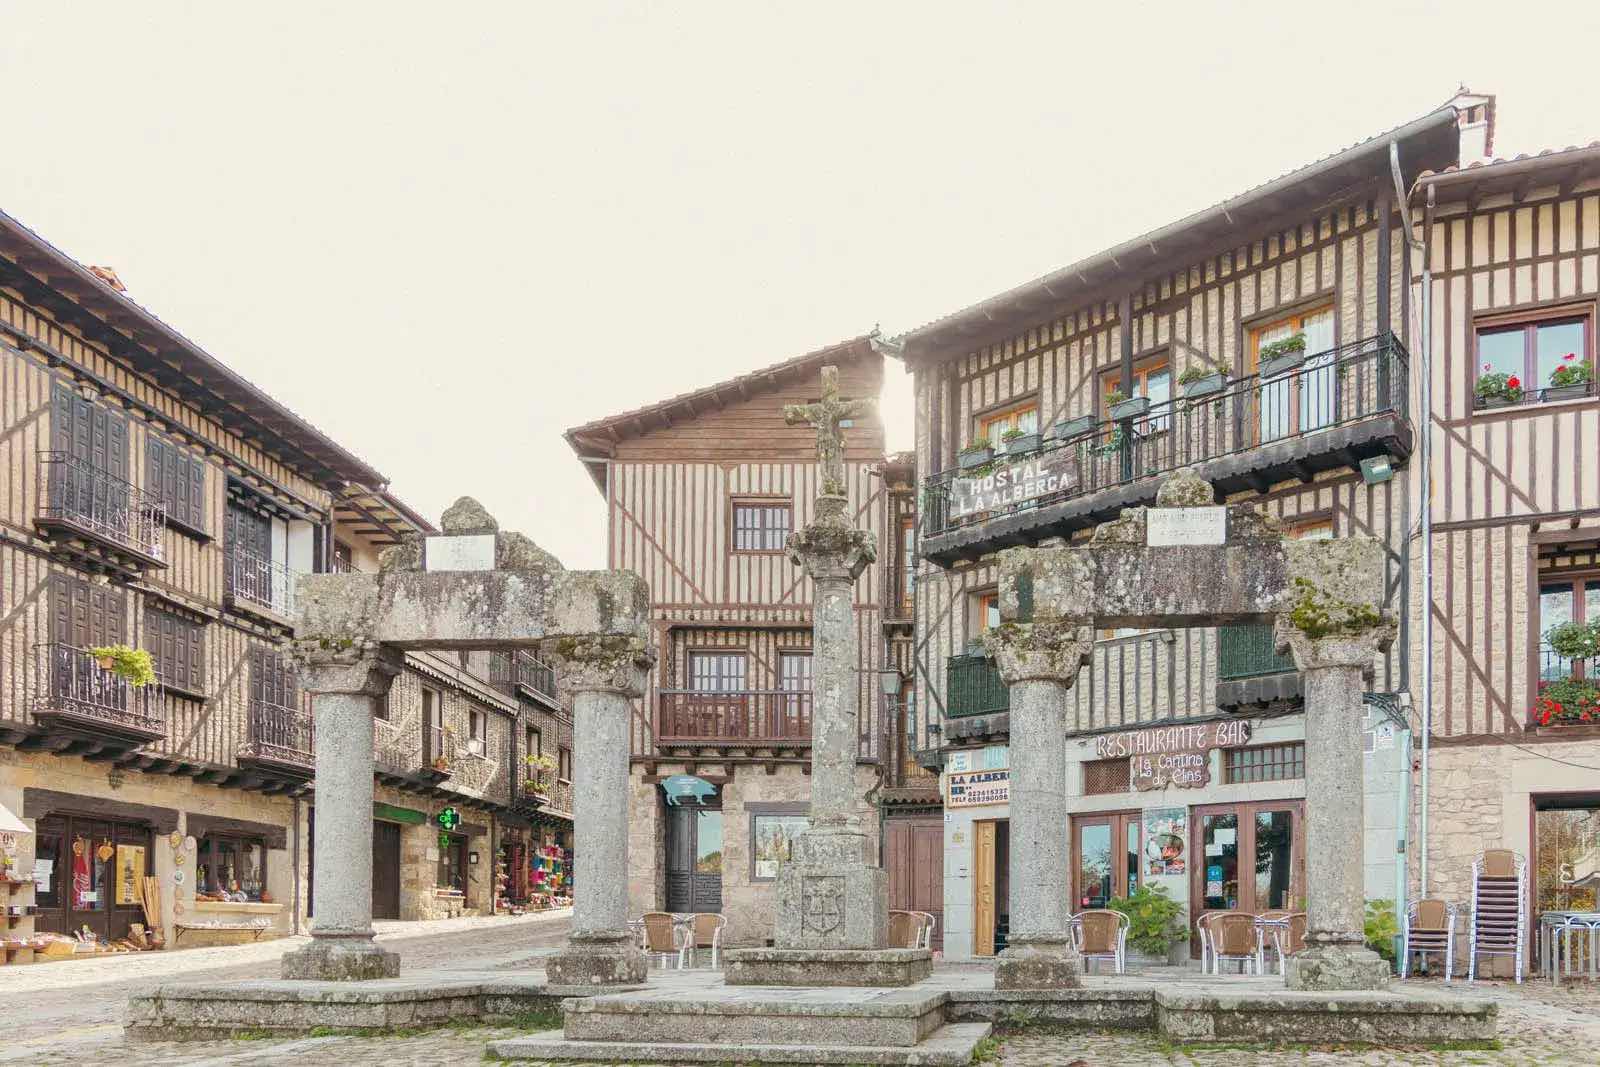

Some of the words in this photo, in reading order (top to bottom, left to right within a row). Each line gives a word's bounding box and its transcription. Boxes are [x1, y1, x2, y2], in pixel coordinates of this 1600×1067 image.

[971, 462, 1048, 495] HOSTAL
[960, 499, 985, 513] LA
[991, 472, 1069, 507] ALBERCA
[1096, 726, 1208, 757] RESTAURANTE
[1215, 720, 1249, 746] BAR
[1159, 754, 1204, 768] Cantina
[970, 772, 1009, 783] ALBER
[1152, 770, 1167, 785] de
